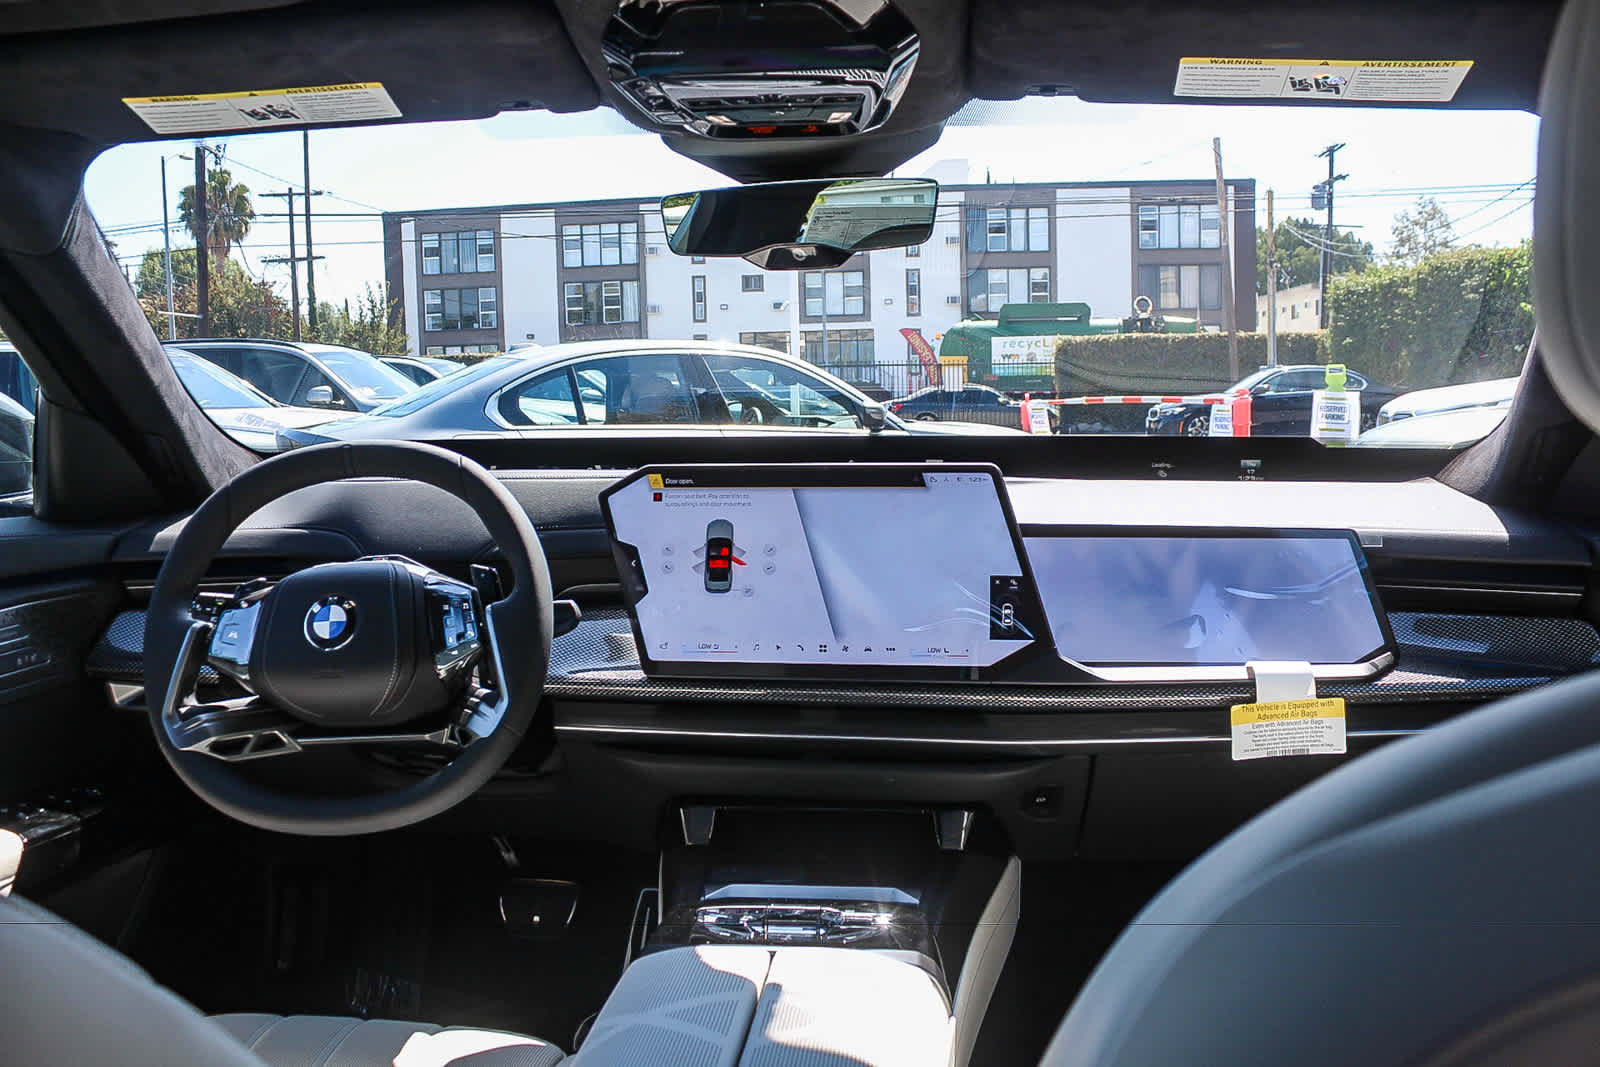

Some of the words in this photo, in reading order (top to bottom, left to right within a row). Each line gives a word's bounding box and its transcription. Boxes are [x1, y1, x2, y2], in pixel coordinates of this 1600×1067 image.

[1256, 703, 1281, 712] Vehicle
[1288, 701, 1319, 712] Equipped
[1257, 712, 1289, 720] Advanced
[1302, 709, 1318, 718] Bags
